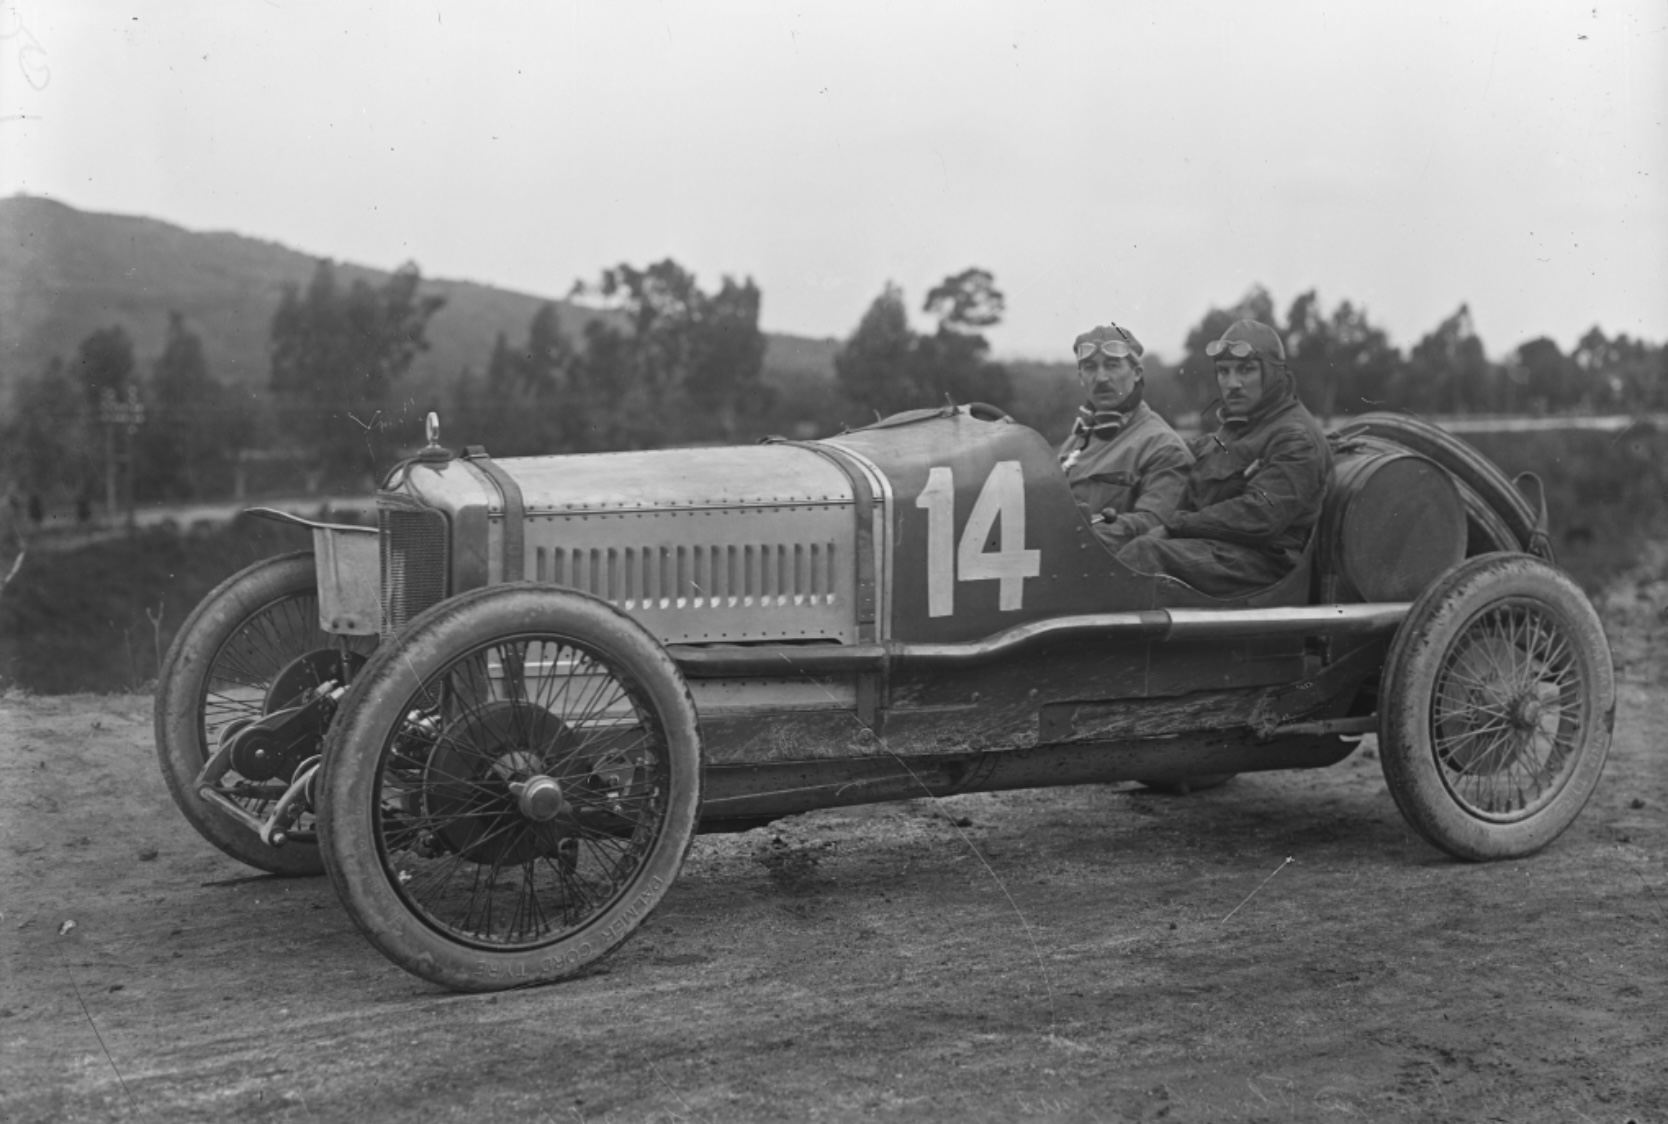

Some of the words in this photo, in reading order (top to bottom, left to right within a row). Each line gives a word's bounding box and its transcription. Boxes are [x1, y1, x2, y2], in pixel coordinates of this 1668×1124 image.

[915, 460, 1041, 617] 14
[601, 875, 664, 942] PALMER
[473, 959, 527, 978] TYRE
